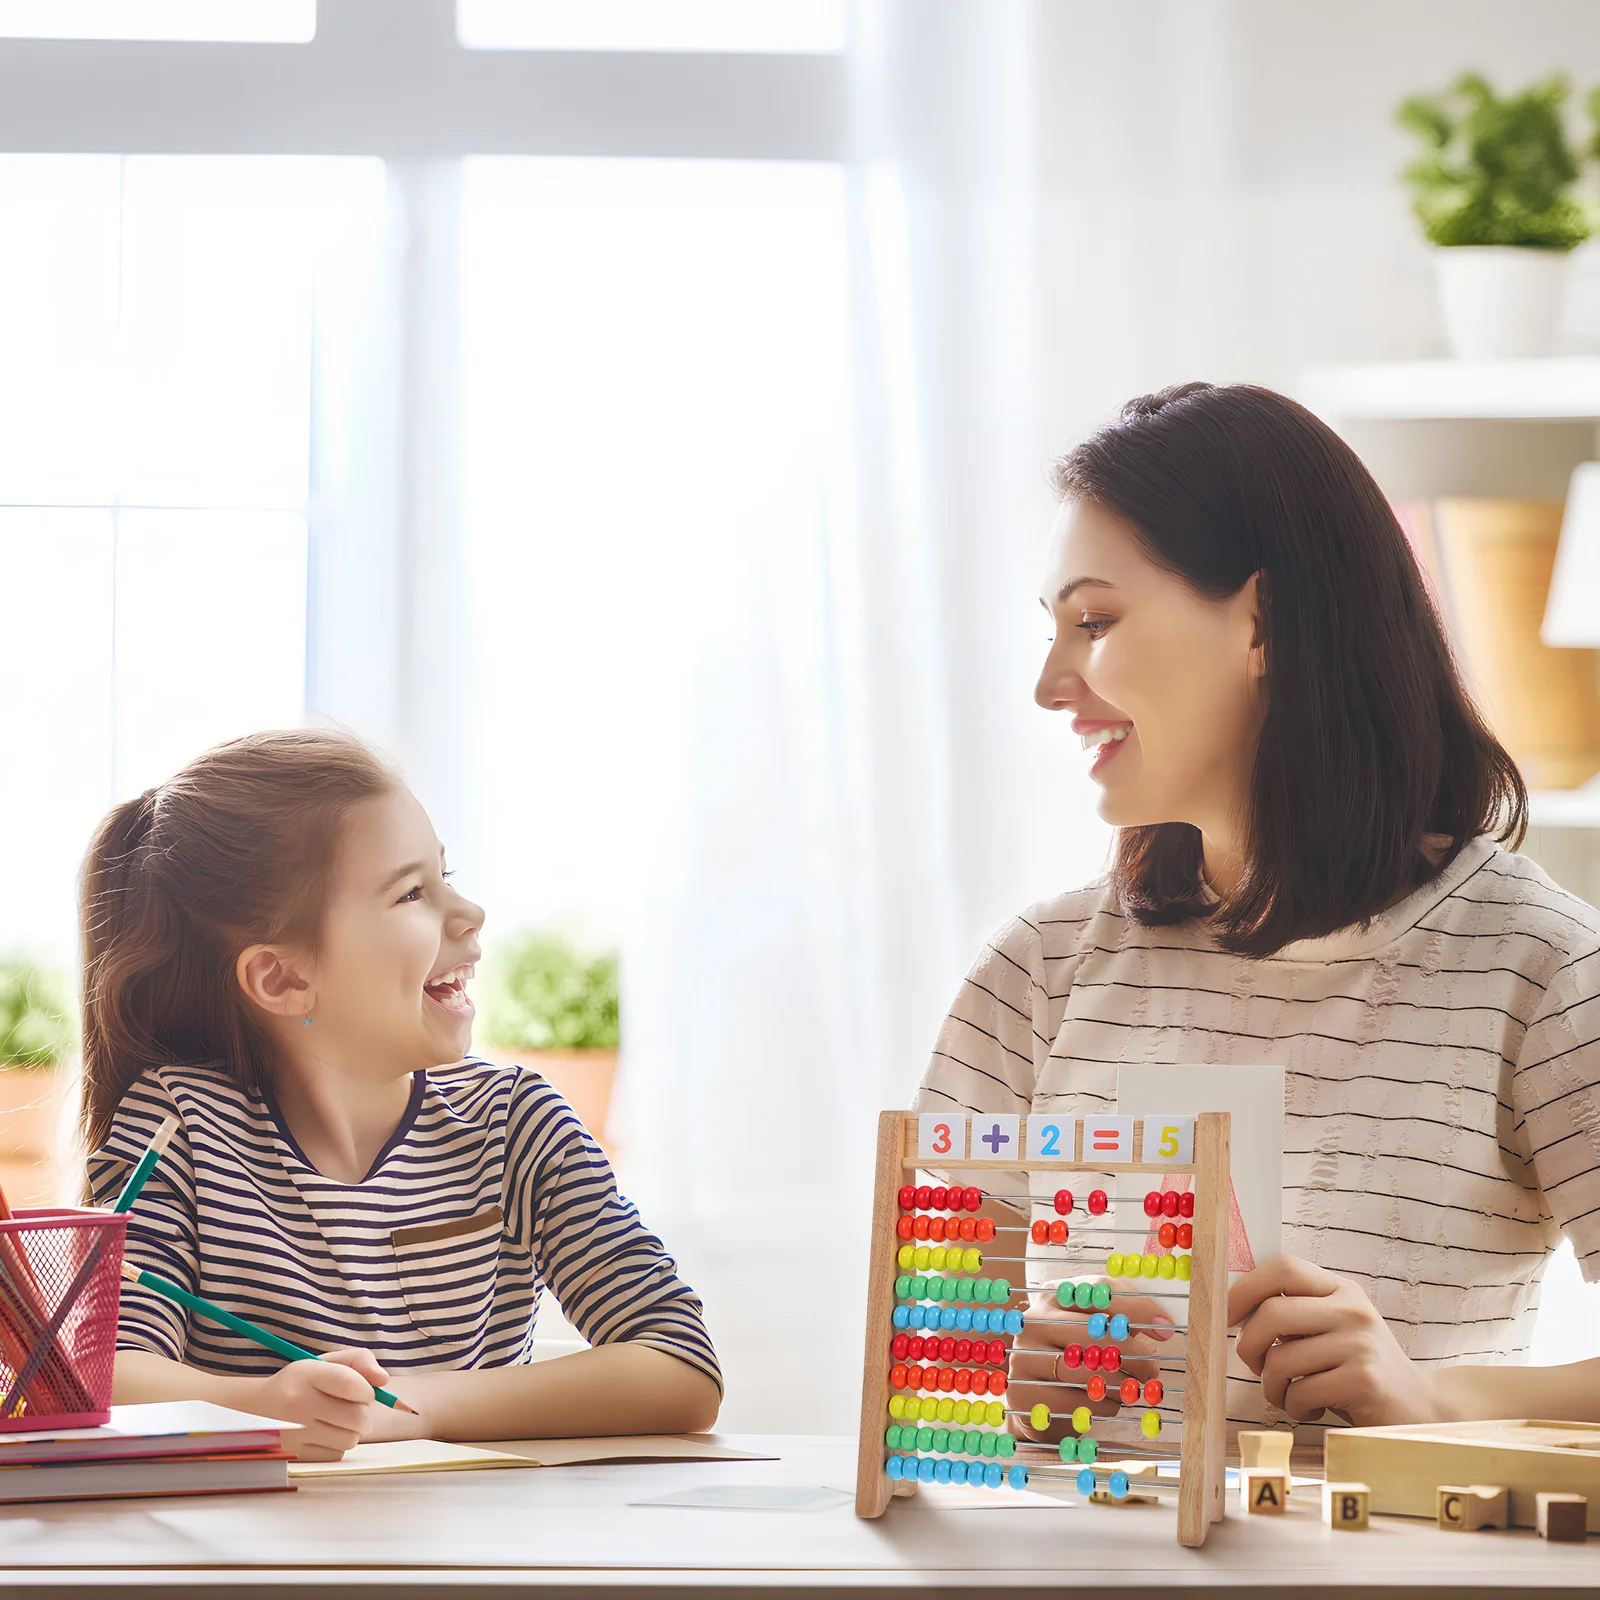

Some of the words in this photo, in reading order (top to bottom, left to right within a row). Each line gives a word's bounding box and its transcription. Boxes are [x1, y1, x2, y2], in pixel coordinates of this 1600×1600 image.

[931, 1123, 952, 1153] 3
[981, 1123, 1010, 1154] +
[1040, 1124, 1061, 1155] 2
[1092, 1129, 1120, 1150] =
[1158, 1126, 1180, 1158] 5
[1256, 1482, 1278, 1506] A
[1342, 1496, 1358, 1520] B
[1445, 1496, 1460, 1521] C
